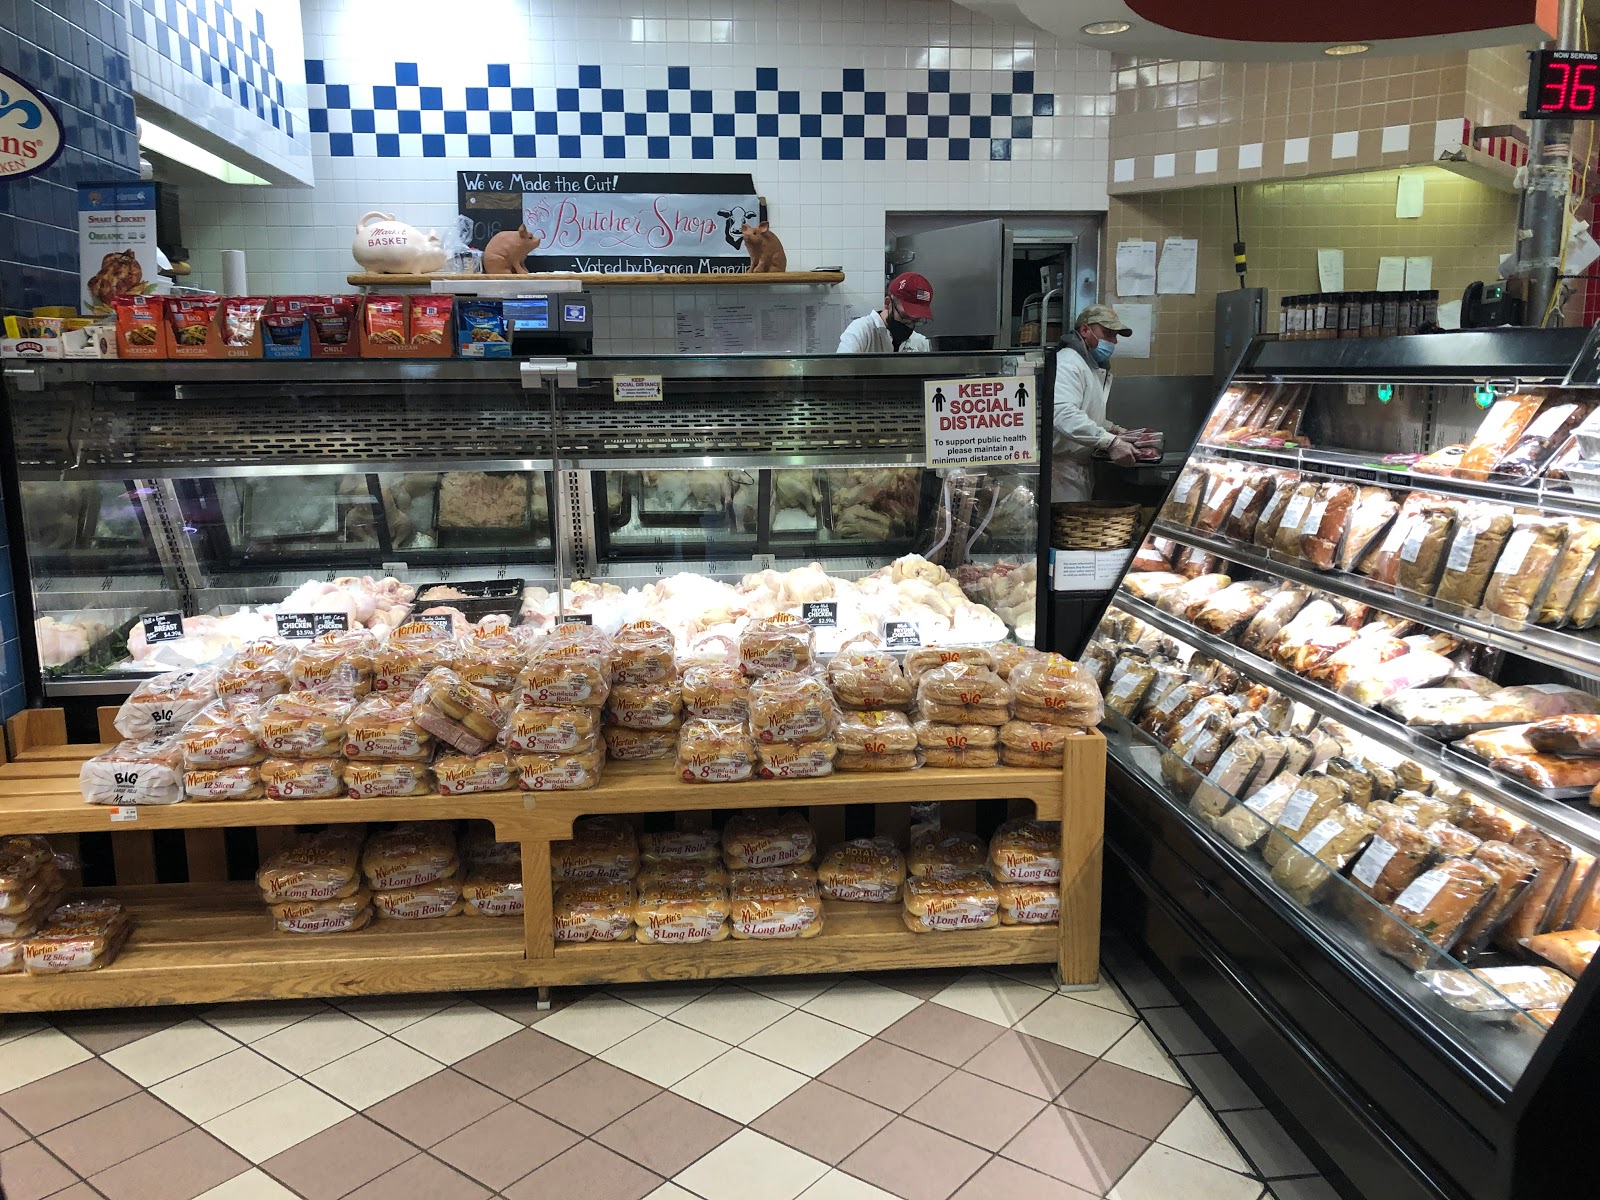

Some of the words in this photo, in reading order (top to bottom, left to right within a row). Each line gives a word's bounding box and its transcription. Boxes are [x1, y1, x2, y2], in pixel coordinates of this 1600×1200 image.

[1541, 63, 1598, 111] 36
[462, 172, 504, 191] We've
[508, 174, 550, 191] Made
[556, 175, 580, 191] the
[584, 174, 619, 192] Cut!
[533, 196, 646, 248] Butcher
[645, 196, 716, 248] Shop
[368, 237, 408, 247] BASKET
[626, 258, 643, 274] by
[644, 258, 694, 274] Bergen
[958, 382, 1004, 398] KEEP
[950, 398, 1013, 414] SOCIAL
[940, 412, 1024, 430] DISTANCE
[946, 437, 976, 446] support
[978, 436, 1001, 445] public
[932, 456, 968, 464] minimum
[970, 454, 1002, 462] distance
[1014, 451, 1020, 460] 6
[1022, 450, 1032, 459] ft.
[947, 447, 972, 456] please
[154, 624, 177, 632] BREAST
[743, 649, 768, 660] Martin's
[940, 652, 960, 662] BIG
[618, 671, 626, 682] 8
[529, 677, 557, 691] Martin's
[539, 689, 548, 700] 8
[960, 692, 981, 705] BIG
[617, 699, 644, 711] Martin's
[694, 697, 720, 708] Martin's
[1044, 697, 1066, 709] BIG
[152, 709, 173, 722] BIG
[623, 711, 633, 722] 8
[264, 724, 293, 738] Martin's
[356, 728, 386, 742] Martin's
[518, 723, 547, 738] Martin's
[778, 724, 786, 735] 8
[273, 737, 283, 748] 8
[365, 740, 375, 752] 8
[527, 736, 536, 748] 8
[946, 736, 968, 748] BIG
[1031, 741, 1053, 752] BIG
[214, 746, 236, 755] Sliced
[864, 743, 886, 754] BIG
[692, 753, 720, 767] Martin's
[770, 753, 798, 767] Martin's
[446, 768, 475, 782] Martin's
[524, 764, 553, 778] Martin's
[700, 766, 710, 777] 8
[779, 766, 788, 776] 8
[114, 773, 138, 786] BIG
[273, 770, 301, 785] Martin's
[353, 770, 381, 785] Martin's
[534, 777, 543, 788] 8
[283, 782, 293, 794] 8
[364, 783, 372, 794] 8
[455, 780, 466, 790] 8
[661, 845, 682, 854] Long
[684, 844, 706, 852] Rolls
[748, 855, 754, 864] 8
[756, 854, 776, 864] Long
[779, 851, 799, 860] Rolls
[1006, 853, 1038, 867] Martin's
[374, 863, 407, 880] Martin's
[564, 868, 570, 877] 8
[571, 868, 594, 878] Long
[597, 868, 620, 878] Rolls
[1009, 869, 1016, 877] 8
[1018, 868, 1041, 879] Long
[271, 874, 303, 892] Martin's
[380, 879, 386, 888] 8
[389, 877, 412, 888] Long
[414, 873, 437, 884] Rolls
[285, 889, 308, 900] Long
[311, 888, 334, 897] Rolls
[830, 888, 837, 897] 8
[839, 888, 861, 898] Long
[384, 891, 415, 909] Martin's
[1015, 894, 1045, 910] Martin's
[422, 904, 444, 915] Rolls
[926, 900, 957, 916] Martin's
[650, 913, 681, 928] Martin's
[741, 908, 773, 923] Martin's
[928, 917, 935, 925] 8
[937, 916, 958, 926] Long
[960, 915, 984, 924] Rolls
[1018, 910, 1024, 919] 8
[1026, 910, 1048, 920] Long
[289, 919, 296, 928] 8
[298, 920, 320, 930] Long
[322, 918, 346, 928] Rolls
[743, 925, 750, 933] 8
[752, 925, 776, 935] Long
[778, 923, 802, 932] Rolls
[567, 930, 589, 940] Long
[592, 930, 614, 938] Rolls
[654, 930, 660, 939] 8
[661, 929, 685, 940] Long
[687, 927, 711, 937] Rolls
[26, 943, 58, 958] Martin's
